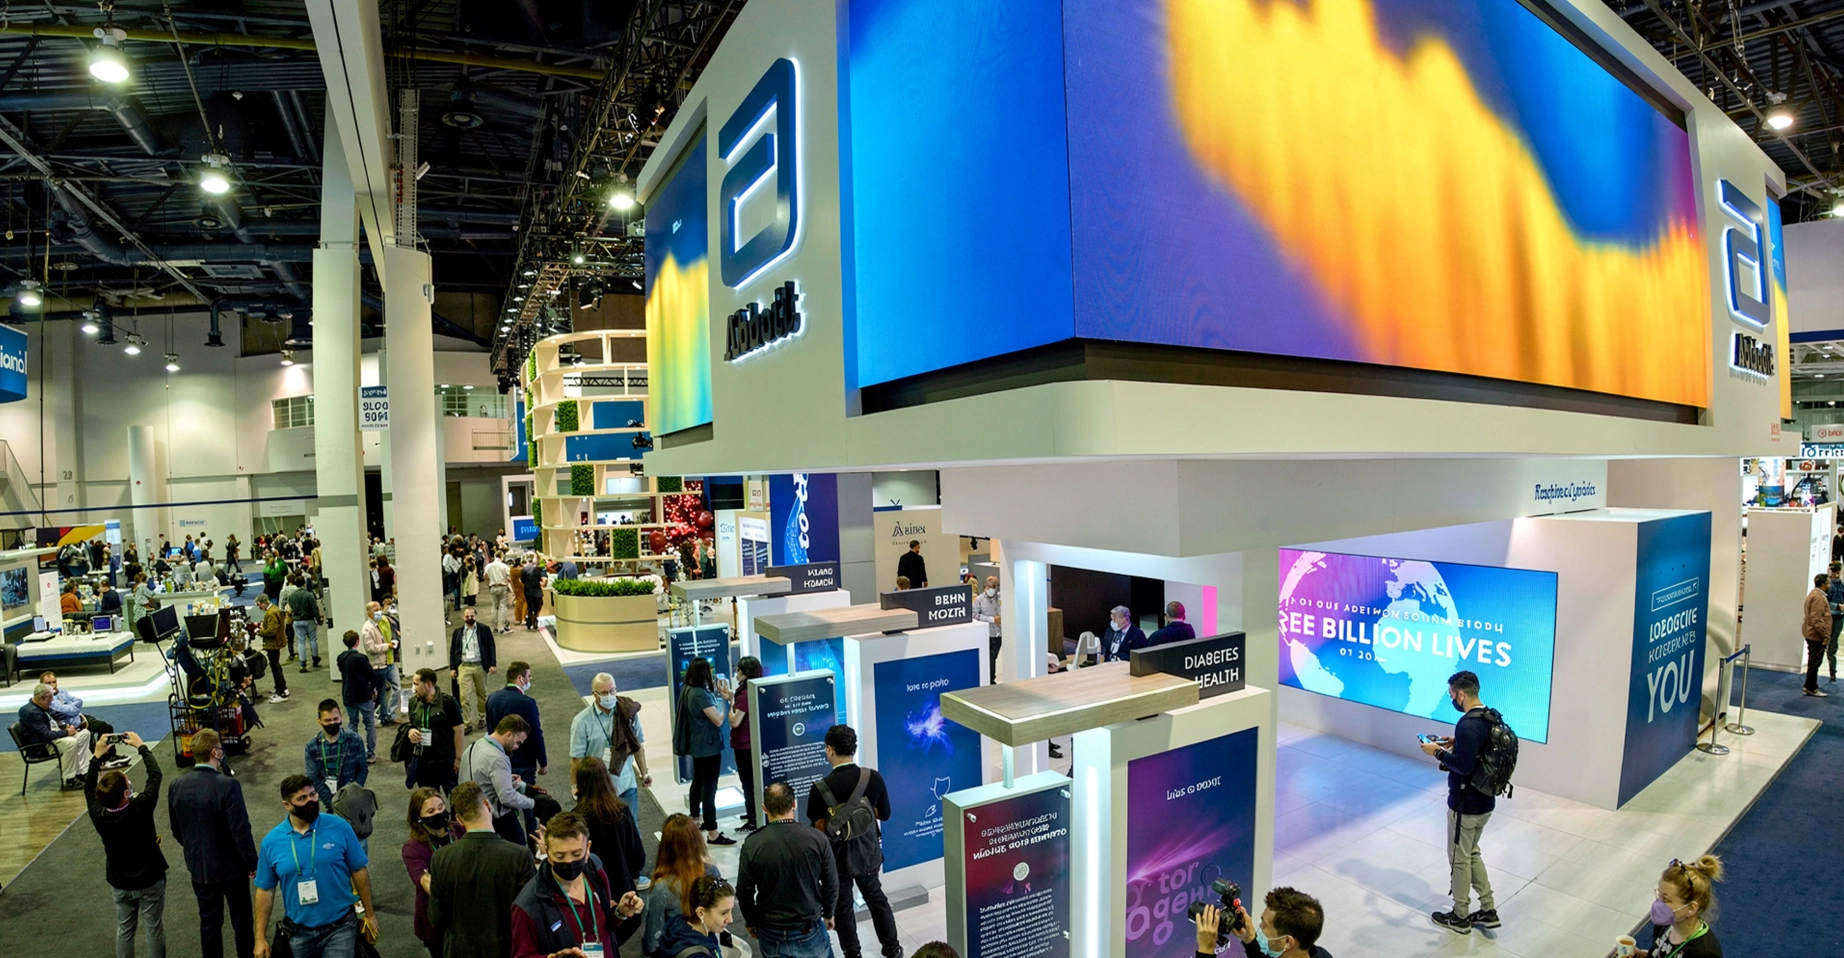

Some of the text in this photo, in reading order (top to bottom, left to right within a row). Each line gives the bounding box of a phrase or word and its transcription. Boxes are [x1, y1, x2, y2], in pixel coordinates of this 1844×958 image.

[1322, 616, 1423, 653] BILLION
[1431, 631, 1513, 668] LIVES
[1646, 648, 1695, 724] YOU
